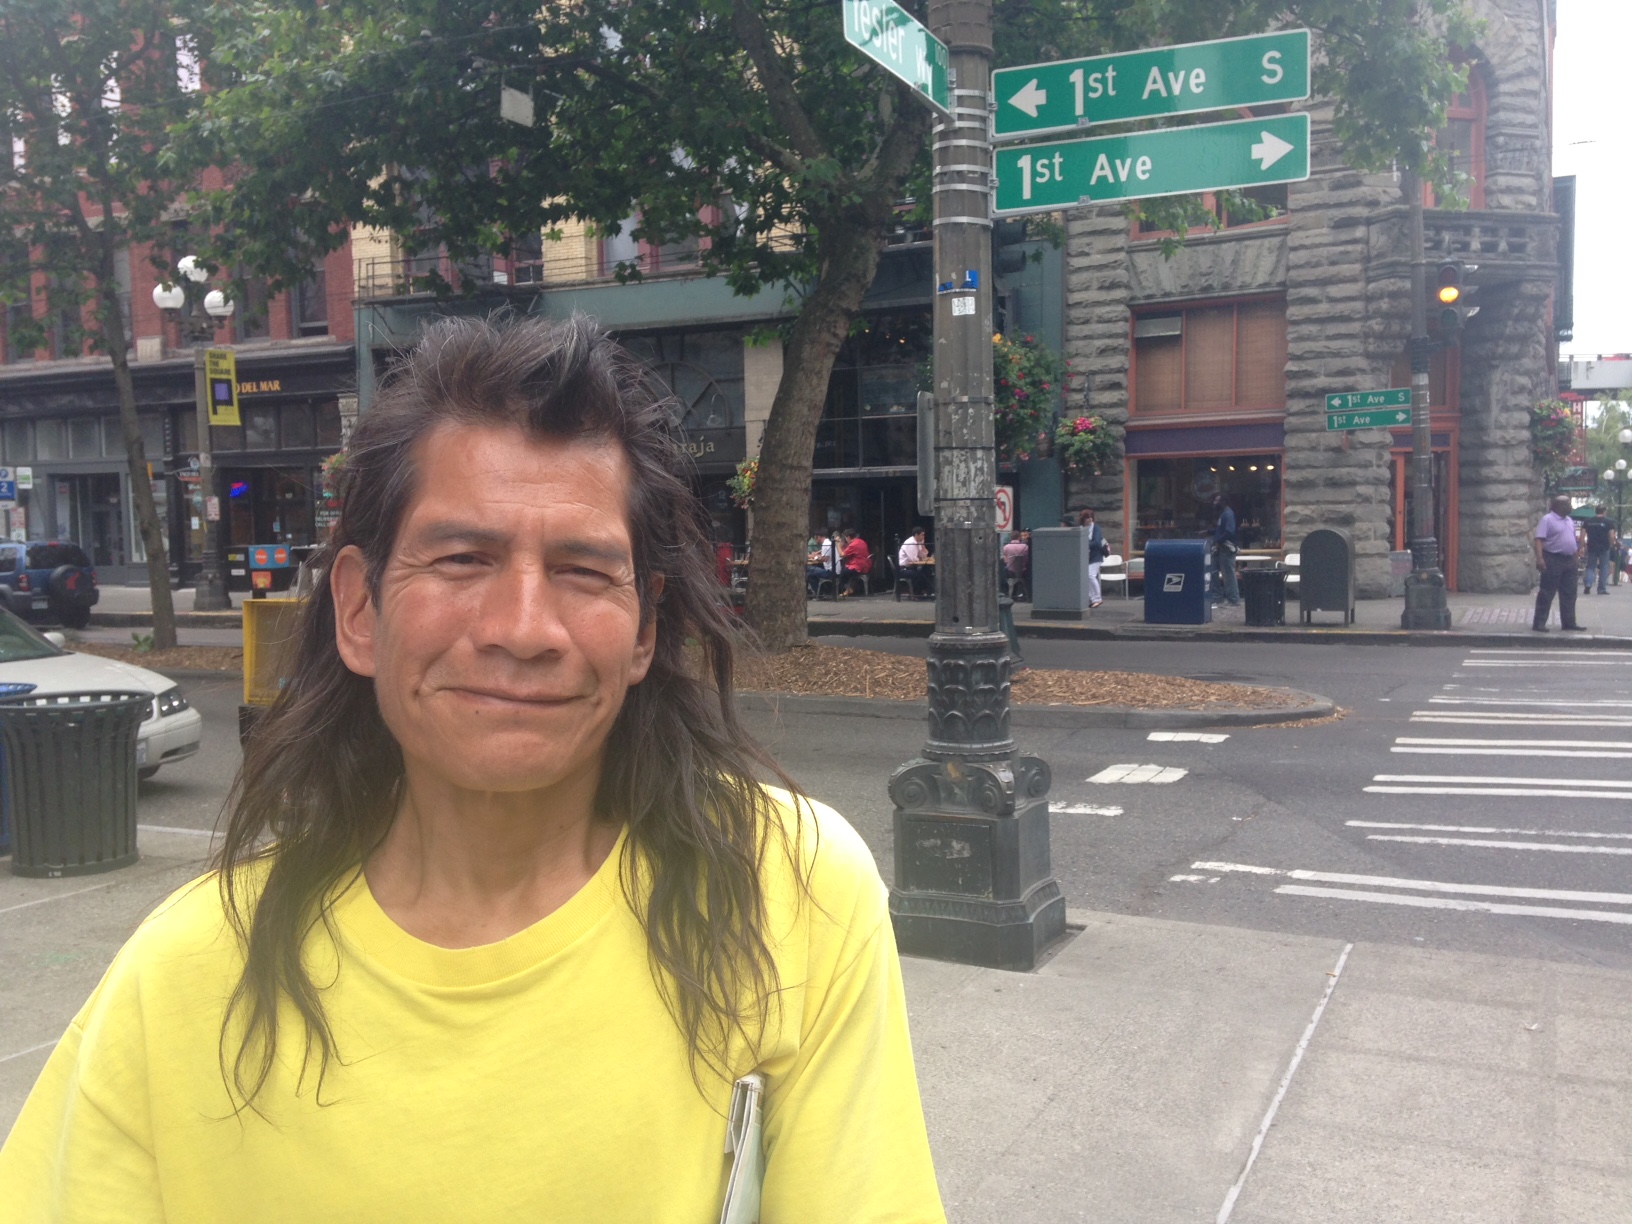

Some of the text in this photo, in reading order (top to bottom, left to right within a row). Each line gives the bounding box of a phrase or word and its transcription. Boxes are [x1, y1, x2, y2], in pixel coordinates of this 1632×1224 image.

[1069, 50, 1283, 116] 1st Ave S
[1017, 151, 1152, 200] 1st Ave
[241, 381, 258, 393] DEL
[259, 380, 281, 392] MAR
[1347, 392, 1405, 407] 1st Ave S
[1333, 415, 1371, 428] 1st Ave
